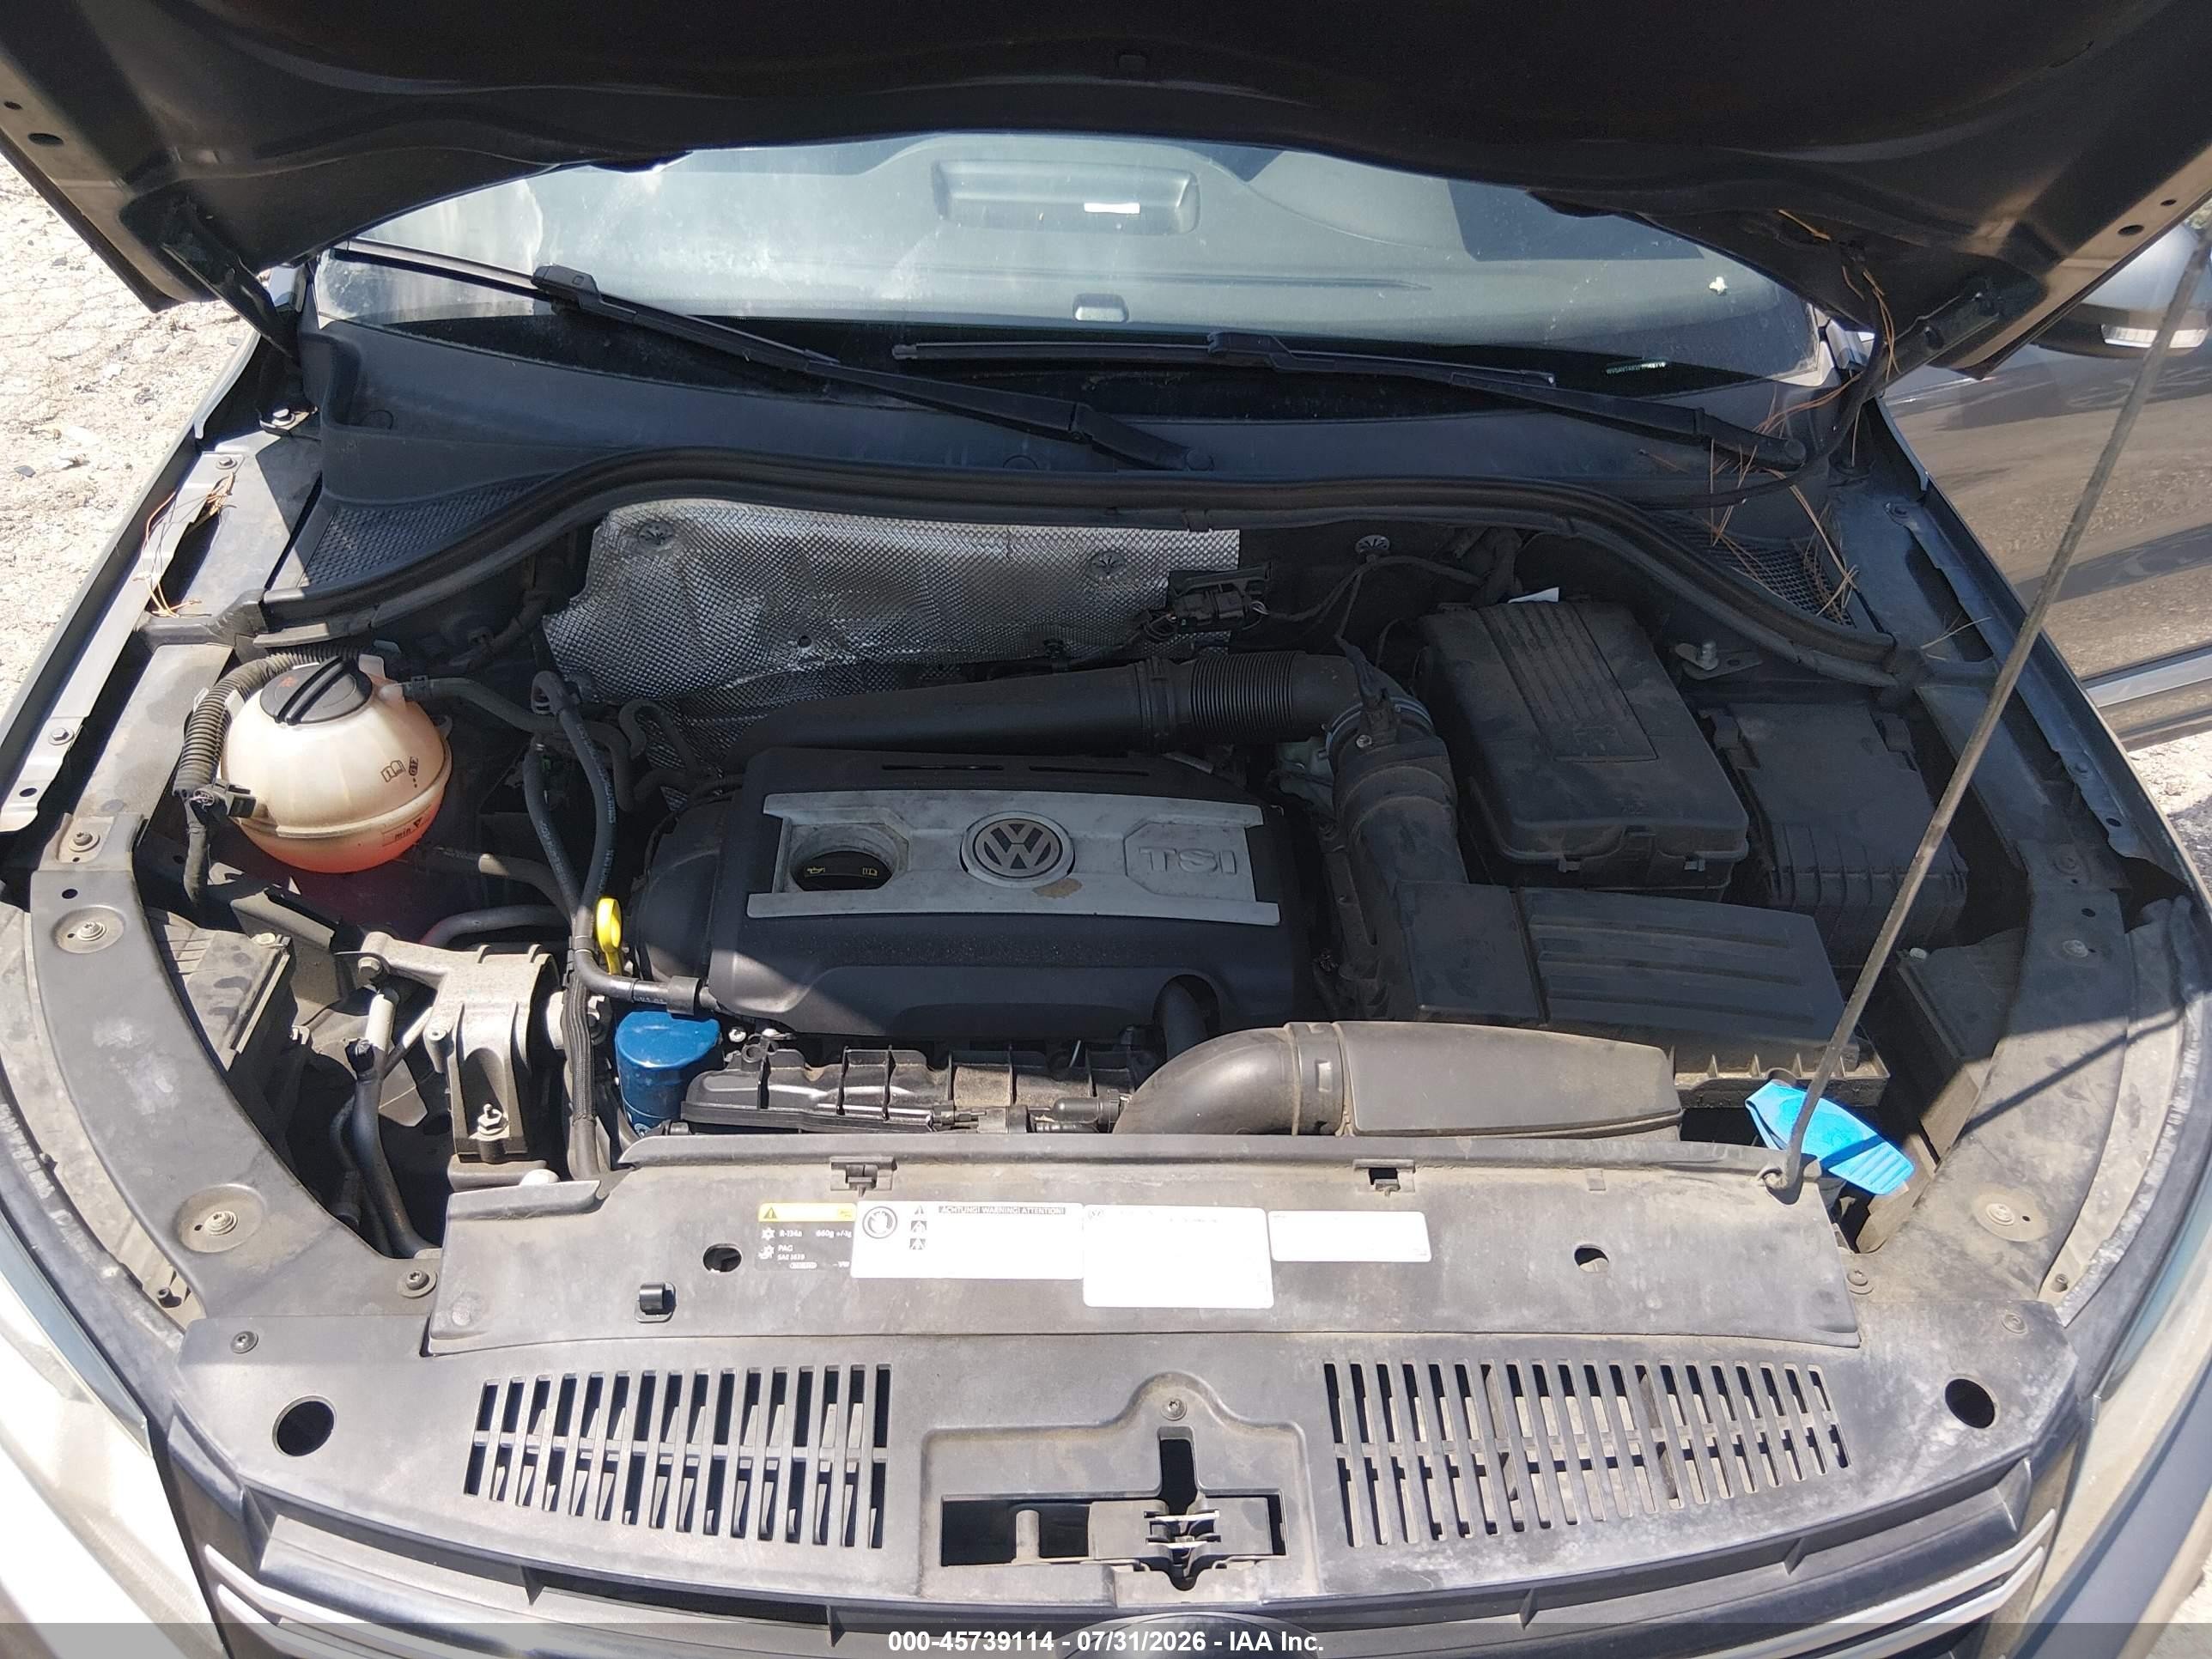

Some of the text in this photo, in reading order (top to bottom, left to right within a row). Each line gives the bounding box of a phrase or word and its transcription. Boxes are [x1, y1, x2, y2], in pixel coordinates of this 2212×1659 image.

[394, 828, 411, 841] min
[1139, 843, 1237, 874] TSI
[981, 1206, 1020, 1214] WARNING!
[1021, 1206, 1065, 1215] ATTENTION!
